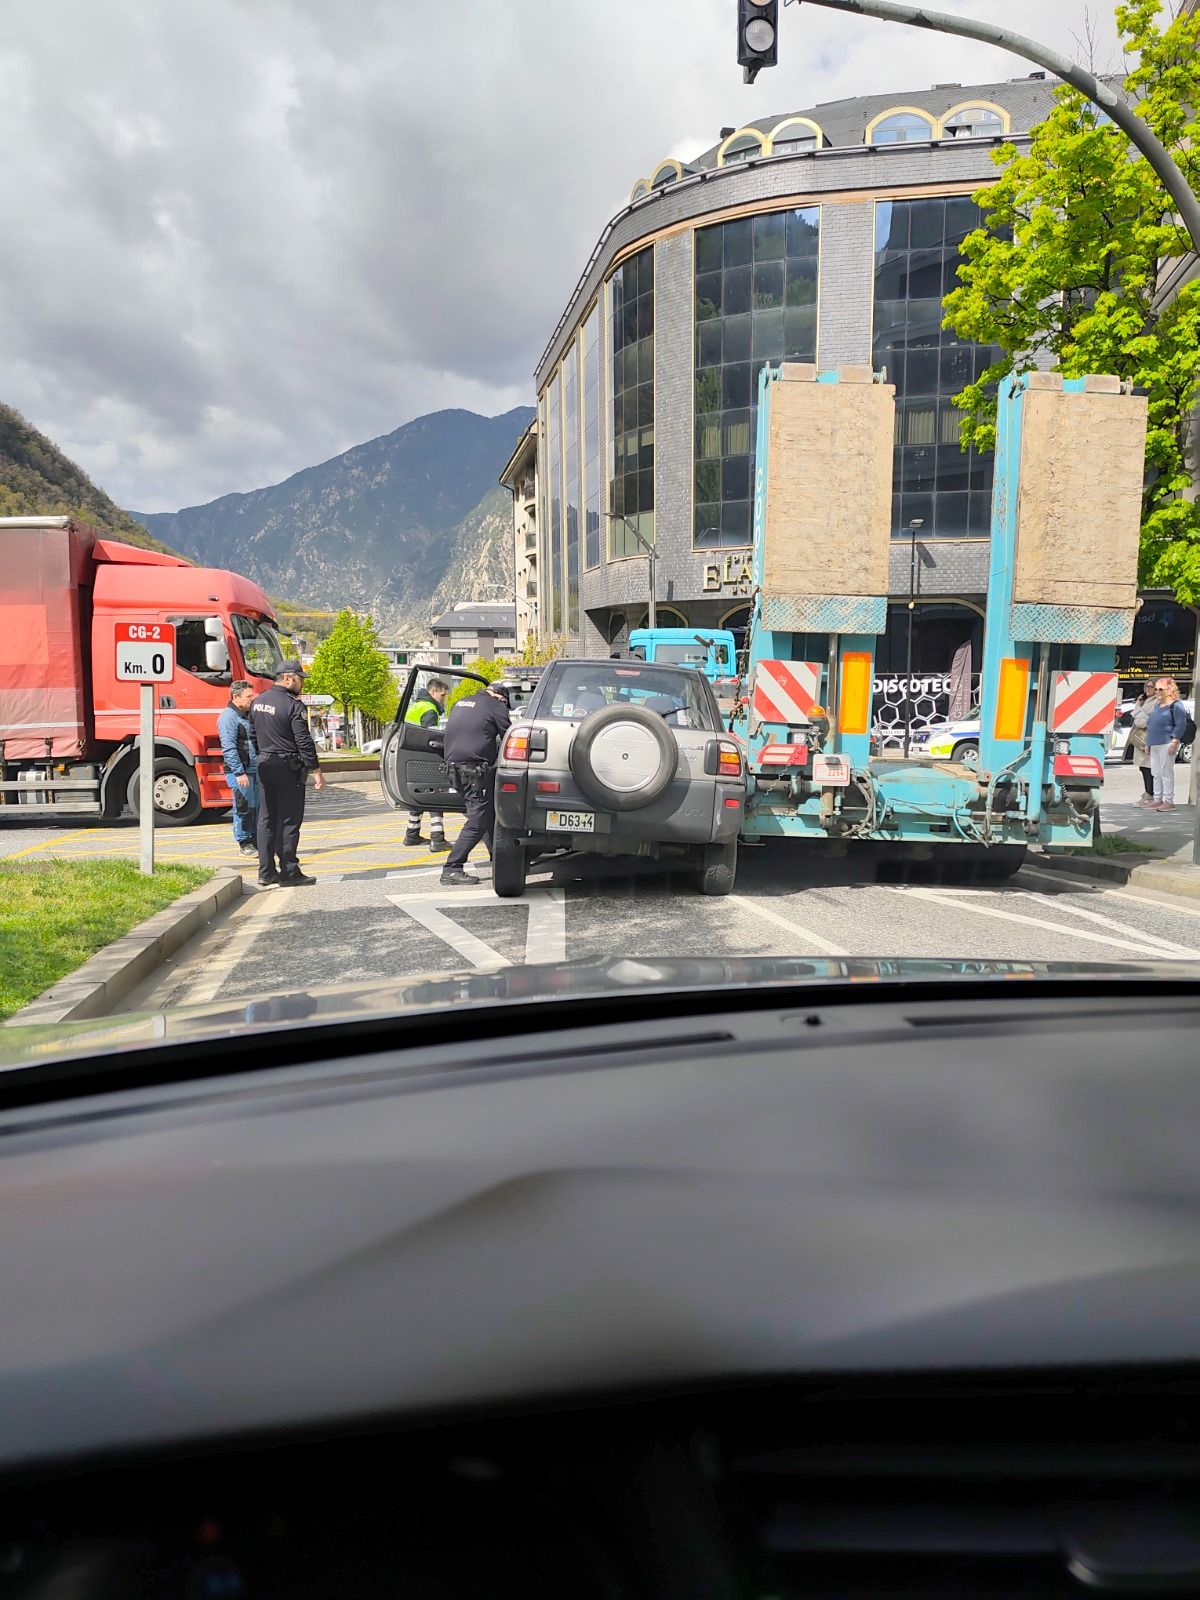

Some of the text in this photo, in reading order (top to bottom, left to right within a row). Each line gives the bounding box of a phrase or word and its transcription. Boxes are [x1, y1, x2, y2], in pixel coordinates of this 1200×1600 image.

[703, 562, 752, 590] ELA
[128, 625, 161, 639] CG-2
[124, 653, 165, 675] Km. 0
[872, 679, 952, 693] DISCOTEC
[559, 813, 593, 828] D6344
